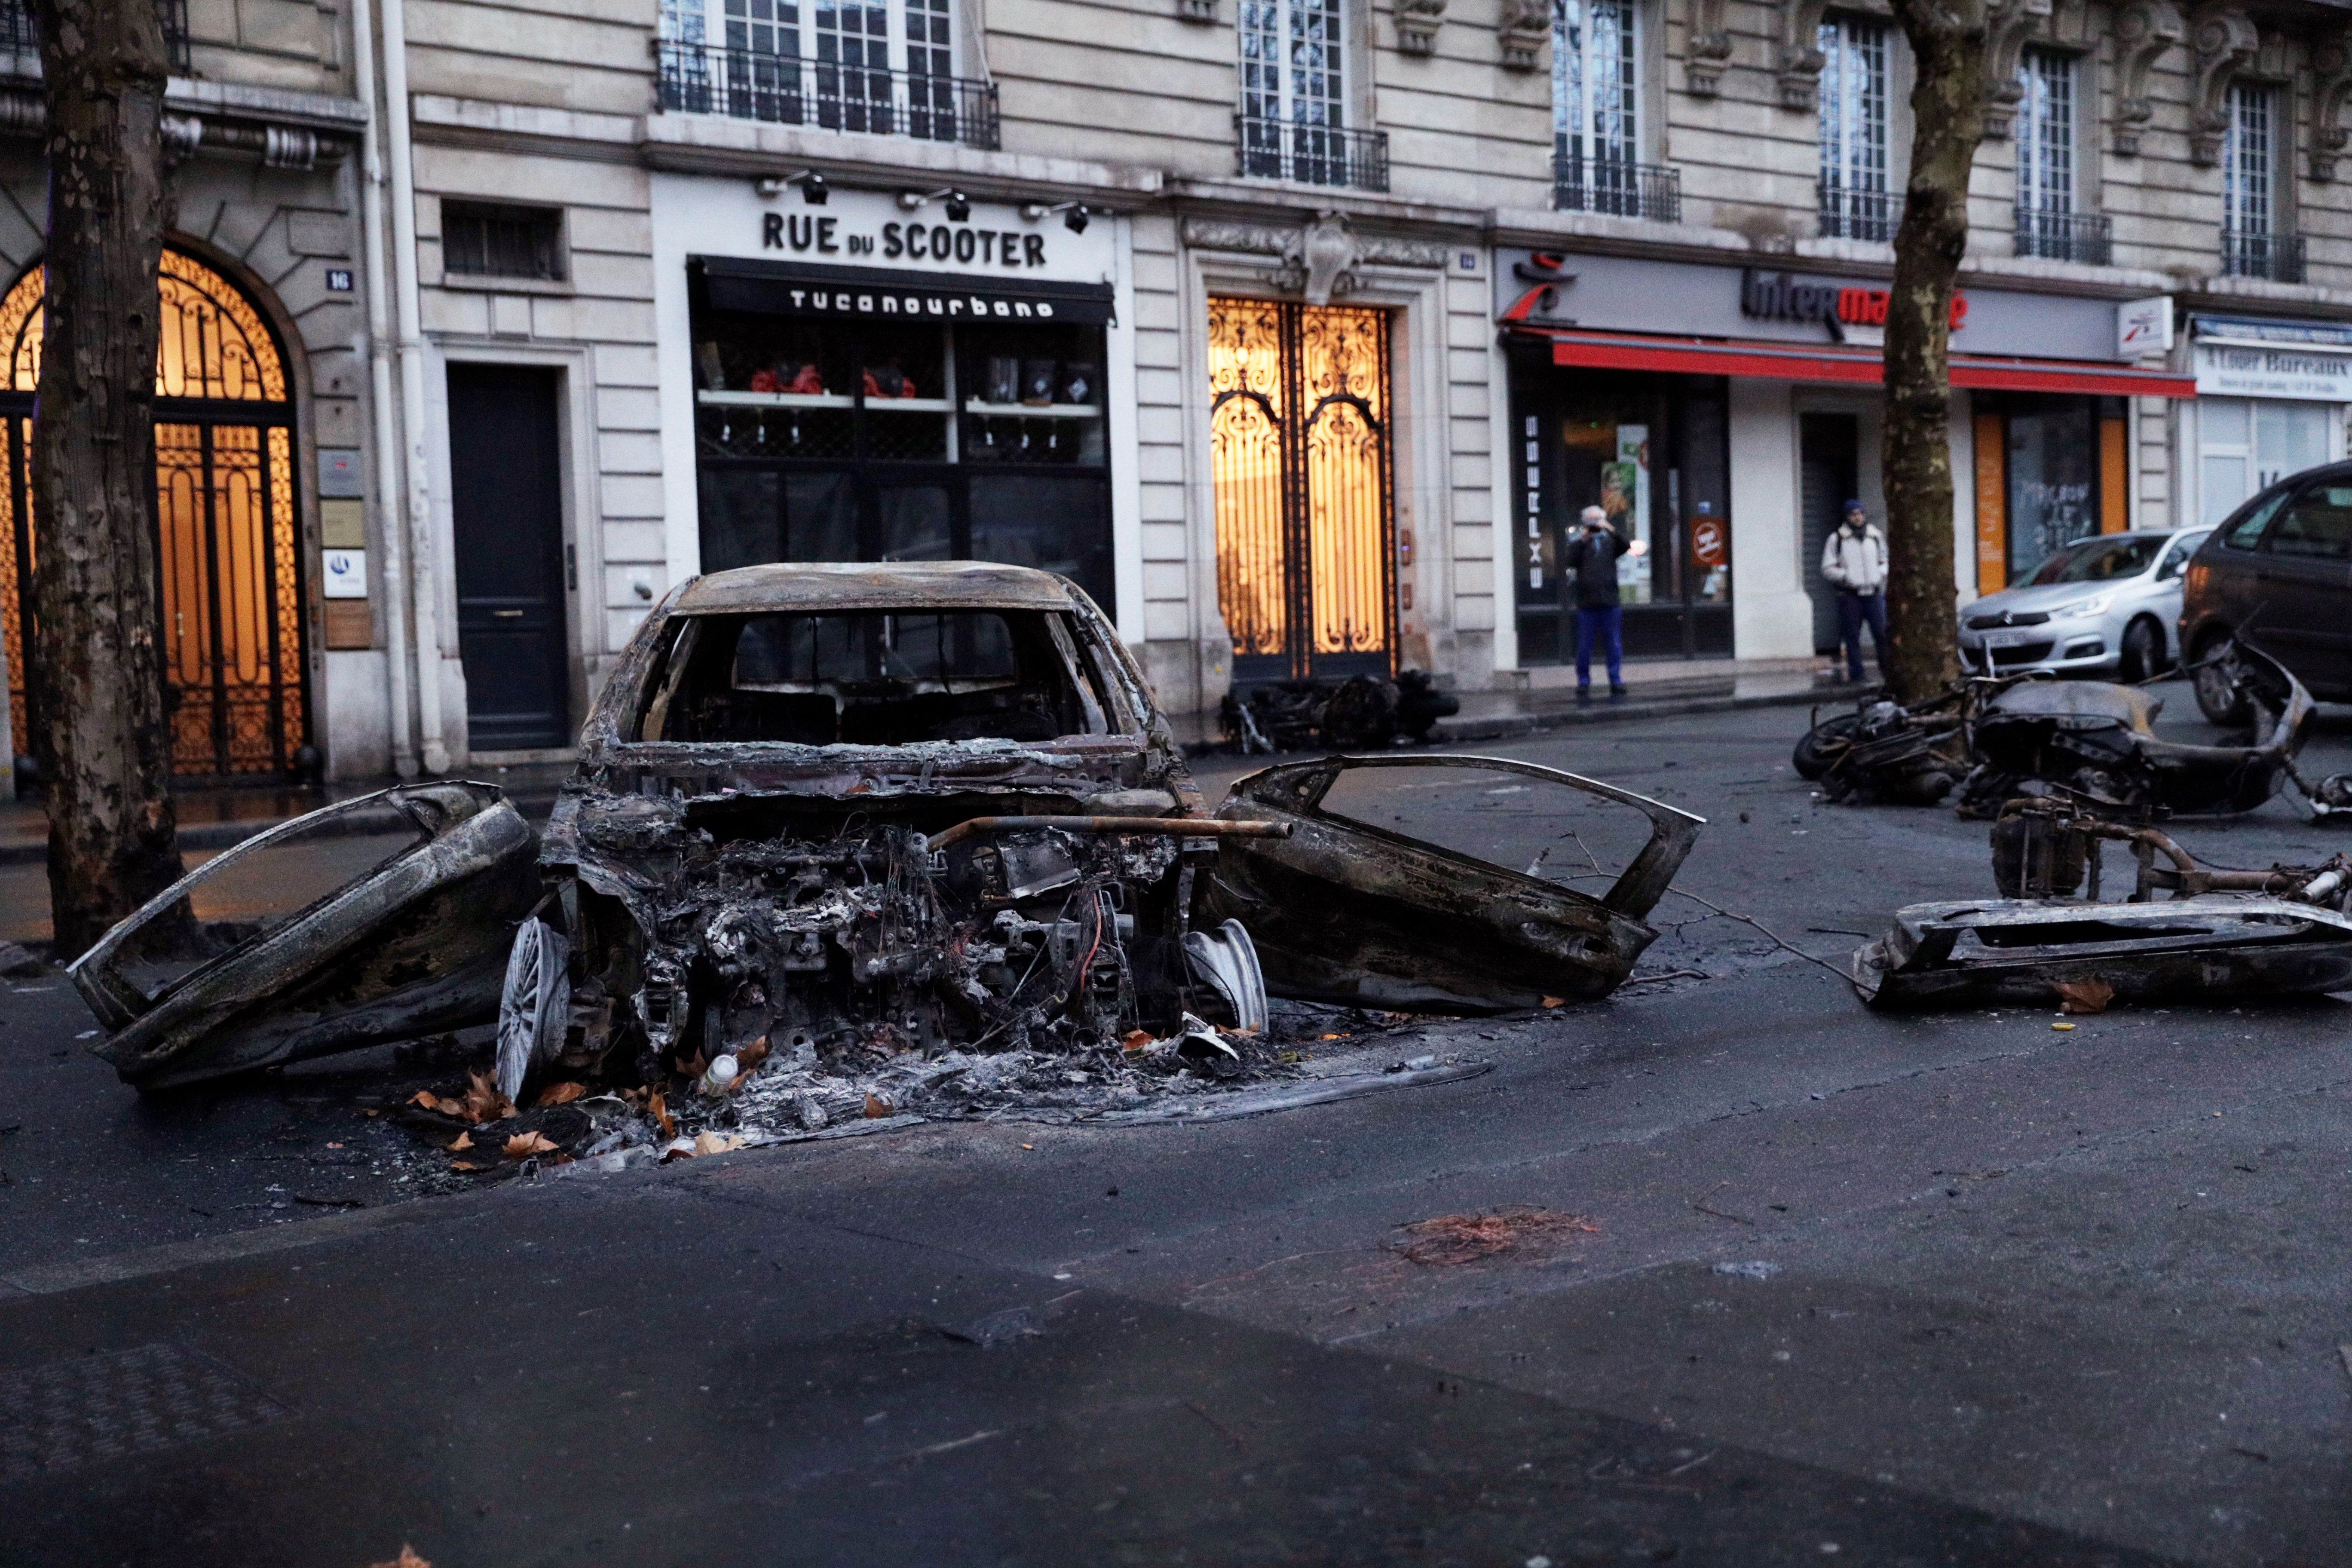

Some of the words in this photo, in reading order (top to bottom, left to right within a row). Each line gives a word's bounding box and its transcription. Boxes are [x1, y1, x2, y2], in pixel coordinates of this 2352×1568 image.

[763, 211, 839, 254] RUE
[847, 235, 874, 256] DU
[882, 222, 1046, 268] SCOOTER
[331, 272, 349, 289] 16
[1742, 266, 1968, 343] Intermaé
[2265, 350, 2348, 376] Bureaux
[1525, 416, 1543, 589] EXPRESS
